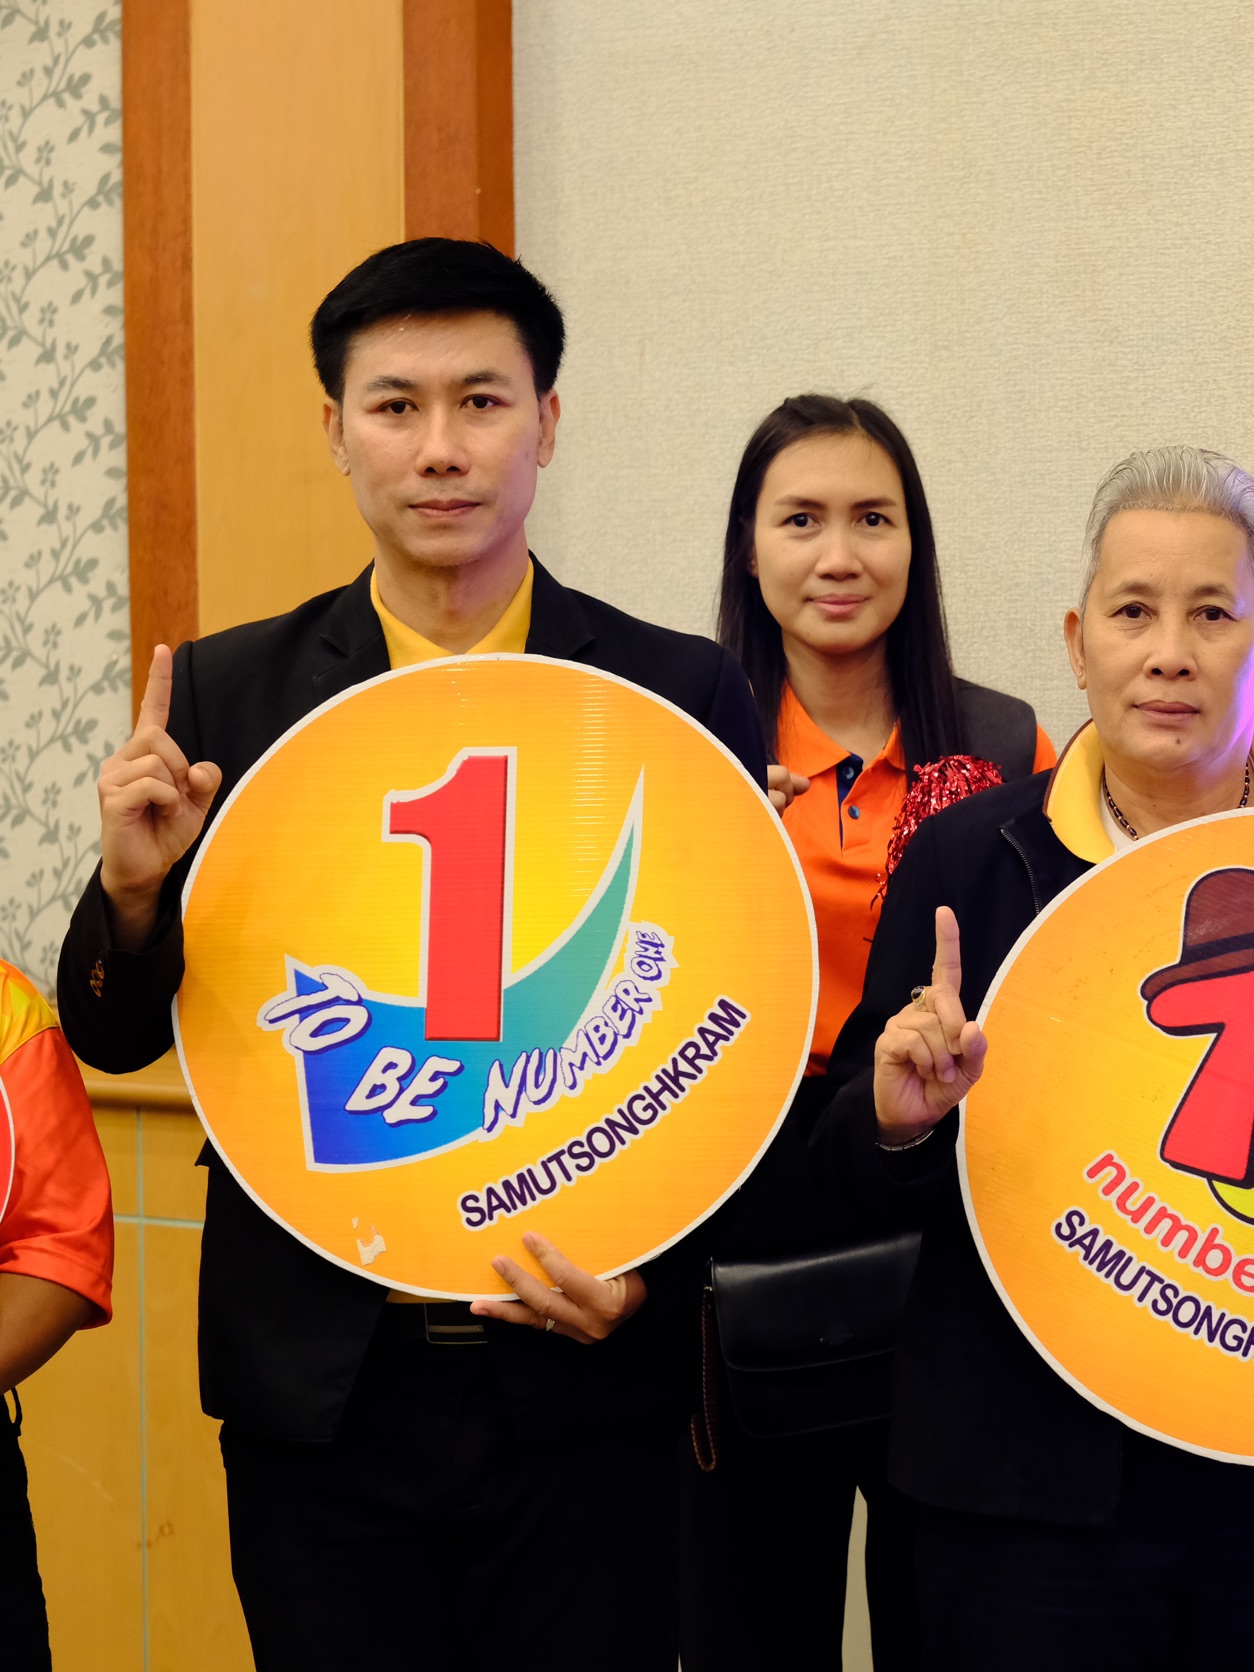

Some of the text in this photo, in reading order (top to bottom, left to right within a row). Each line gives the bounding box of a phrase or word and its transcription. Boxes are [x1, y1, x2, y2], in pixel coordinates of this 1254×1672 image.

[383, 748, 514, 1042] 1
[264, 930, 667, 1133] TO BE NUMBER ONE
[459, 997, 748, 1229] SAMUTSONGHKRAM
